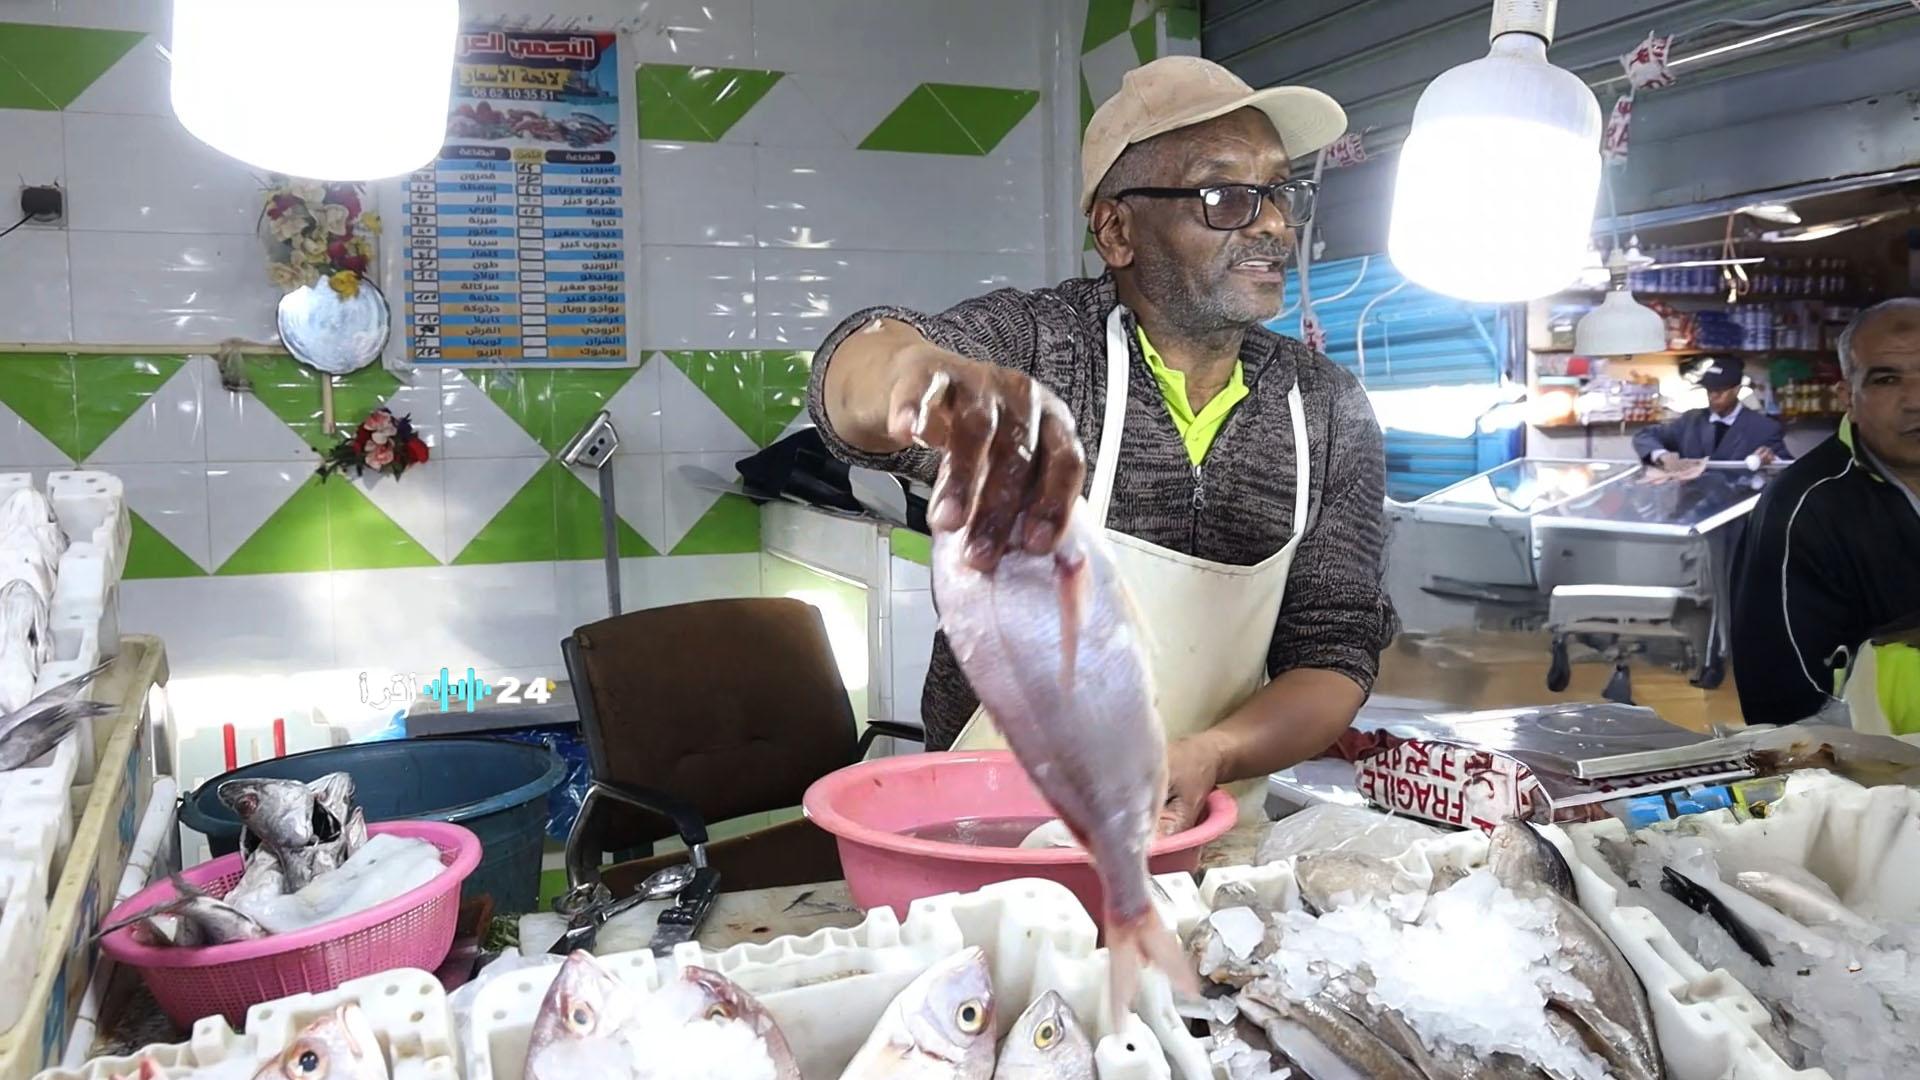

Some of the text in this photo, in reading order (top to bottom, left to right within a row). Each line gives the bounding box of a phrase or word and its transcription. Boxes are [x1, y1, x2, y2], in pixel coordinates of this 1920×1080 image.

[456, 32, 596, 62] النجمي العر
[520, 70, 560, 86] لائحة
[508, 88, 521, 98] 10
[1363, 769, 1465, 825] FRAGILE
